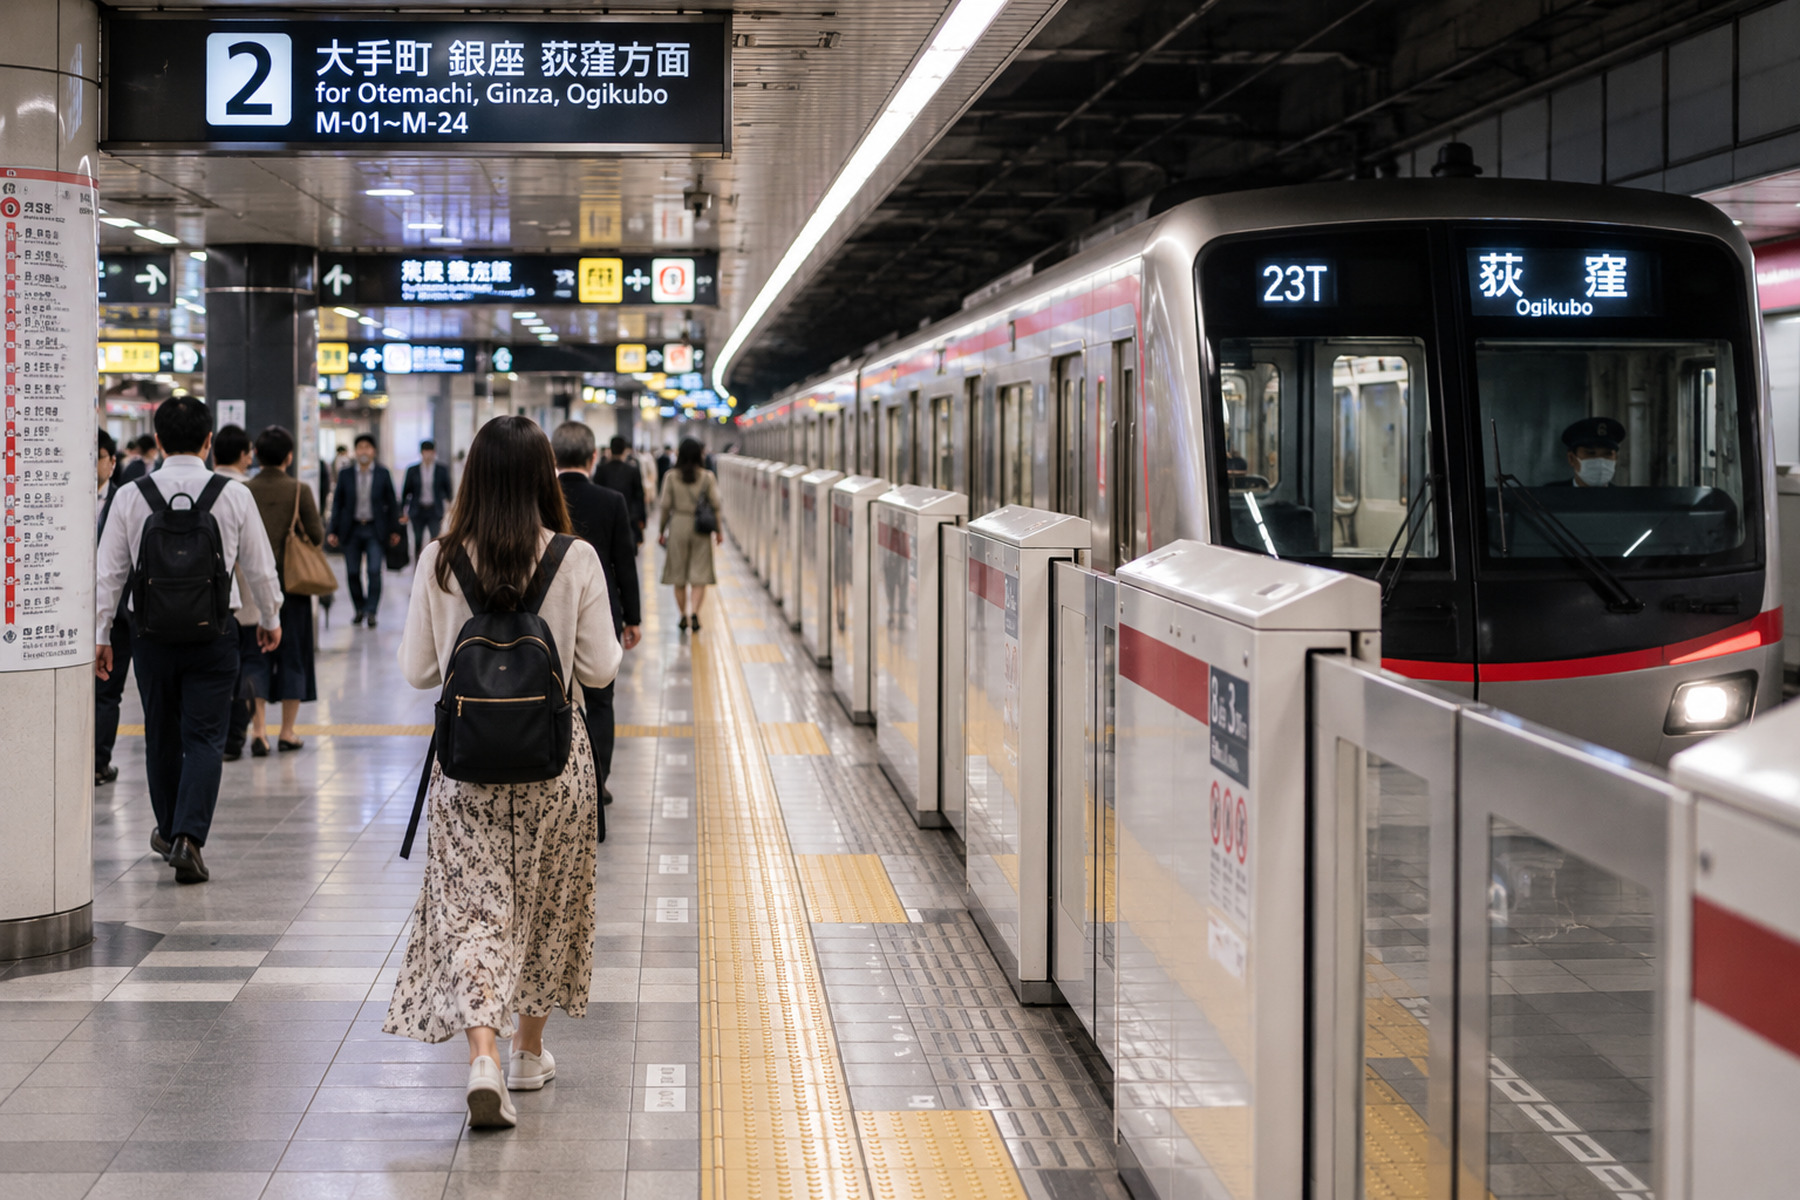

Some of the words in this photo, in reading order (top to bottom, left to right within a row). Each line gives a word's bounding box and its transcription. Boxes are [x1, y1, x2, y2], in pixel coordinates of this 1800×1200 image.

[316, 38, 433, 77] 大手町
[448, 39, 525, 77] 銀座
[541, 40, 690, 78] 荻窪方面
[225, 41, 273, 116] 2
[315, 81, 351, 103] for
[358, 81, 479, 107] Otemachi,
[486, 82, 560, 107] Ginza,
[567, 82, 668, 110] Ogikubo
[1262, 264, 1328, 302] 23T
[1516, 298, 1594, 317] Ogikubo
